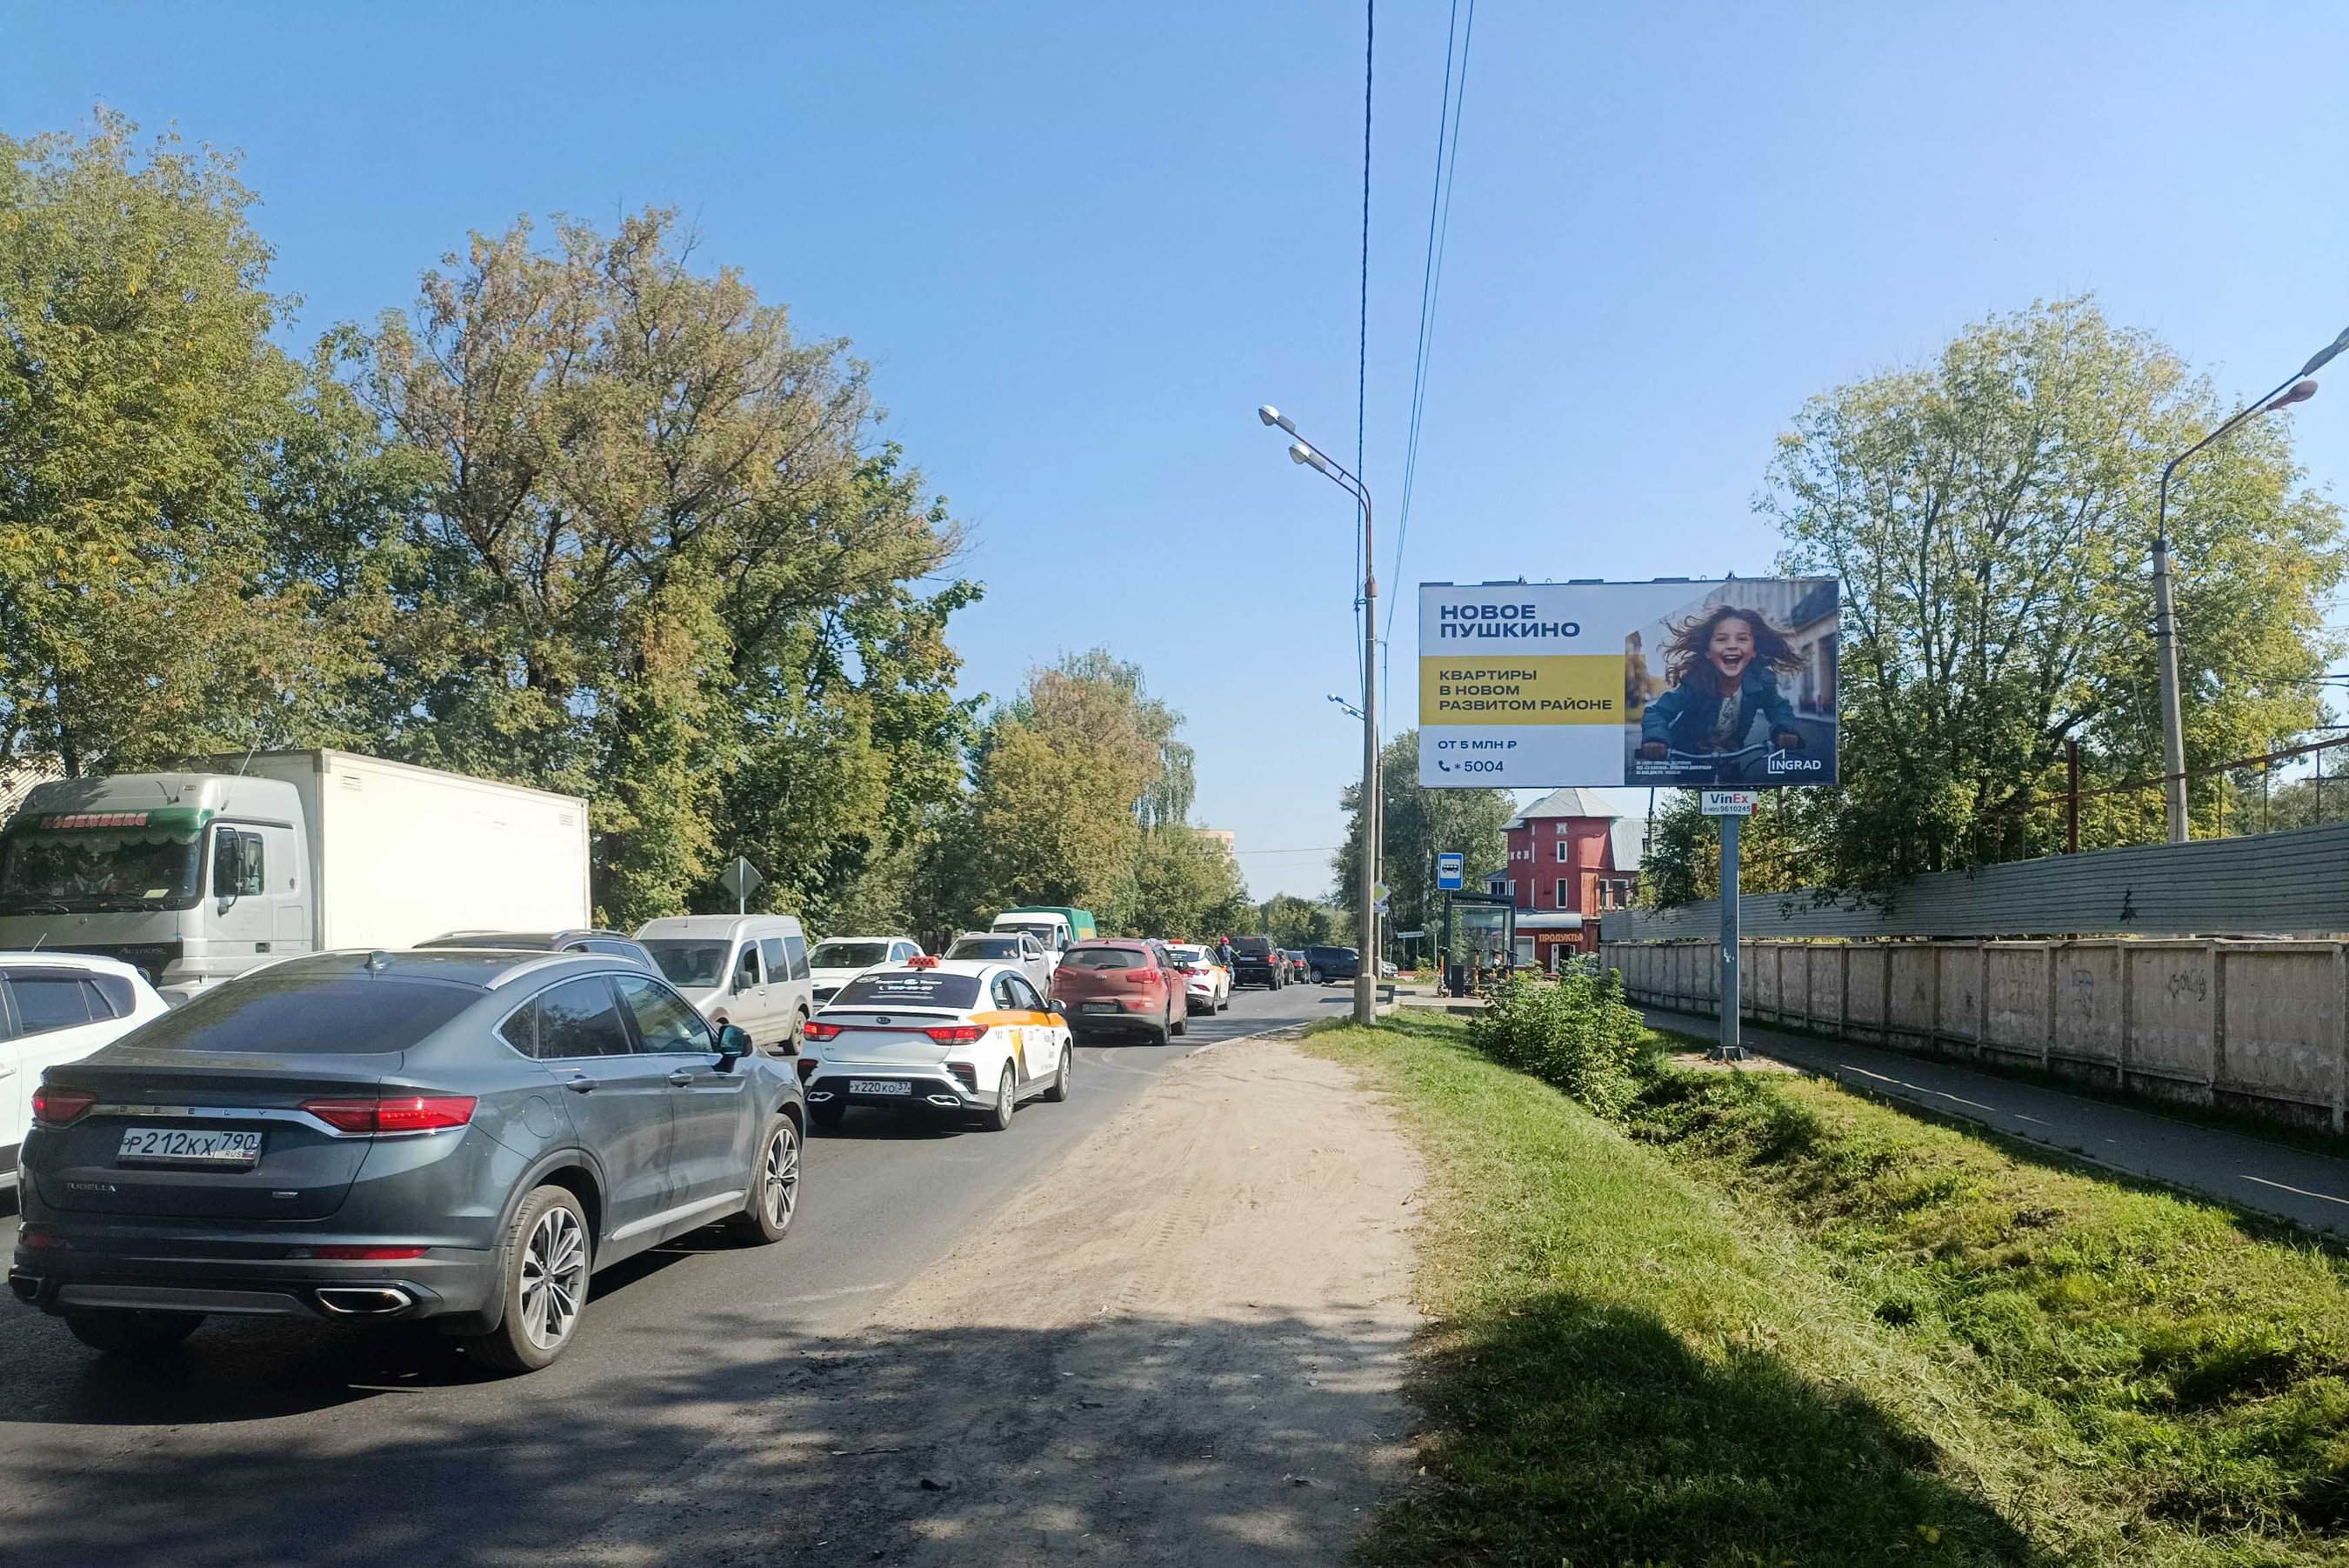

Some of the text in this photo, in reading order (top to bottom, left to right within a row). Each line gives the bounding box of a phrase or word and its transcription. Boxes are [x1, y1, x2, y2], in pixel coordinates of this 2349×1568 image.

[1440, 604, 1536, 620] НОВОЕ
[1440, 622, 1581, 638] ПУШКИНО
[1439, 670, 1538, 681] КВАРТИРЫ
[1439, 685, 1520, 696] В НОВОМ
[1439, 697, 1612, 711] РАЗВИТОМ РАЙОНЕ
[1438, 740, 1457, 750] ОТ
[1460, 740, 1469, 750] 5
[1471, 740, 1504, 750] МЛН
[1771, 759, 1822, 771] INGRAD
[1711, 793, 1749, 804] VinEx
[1538, 933, 1584, 944] ПРОДУКТЫ
[220, 1132, 255, 1151] 790
